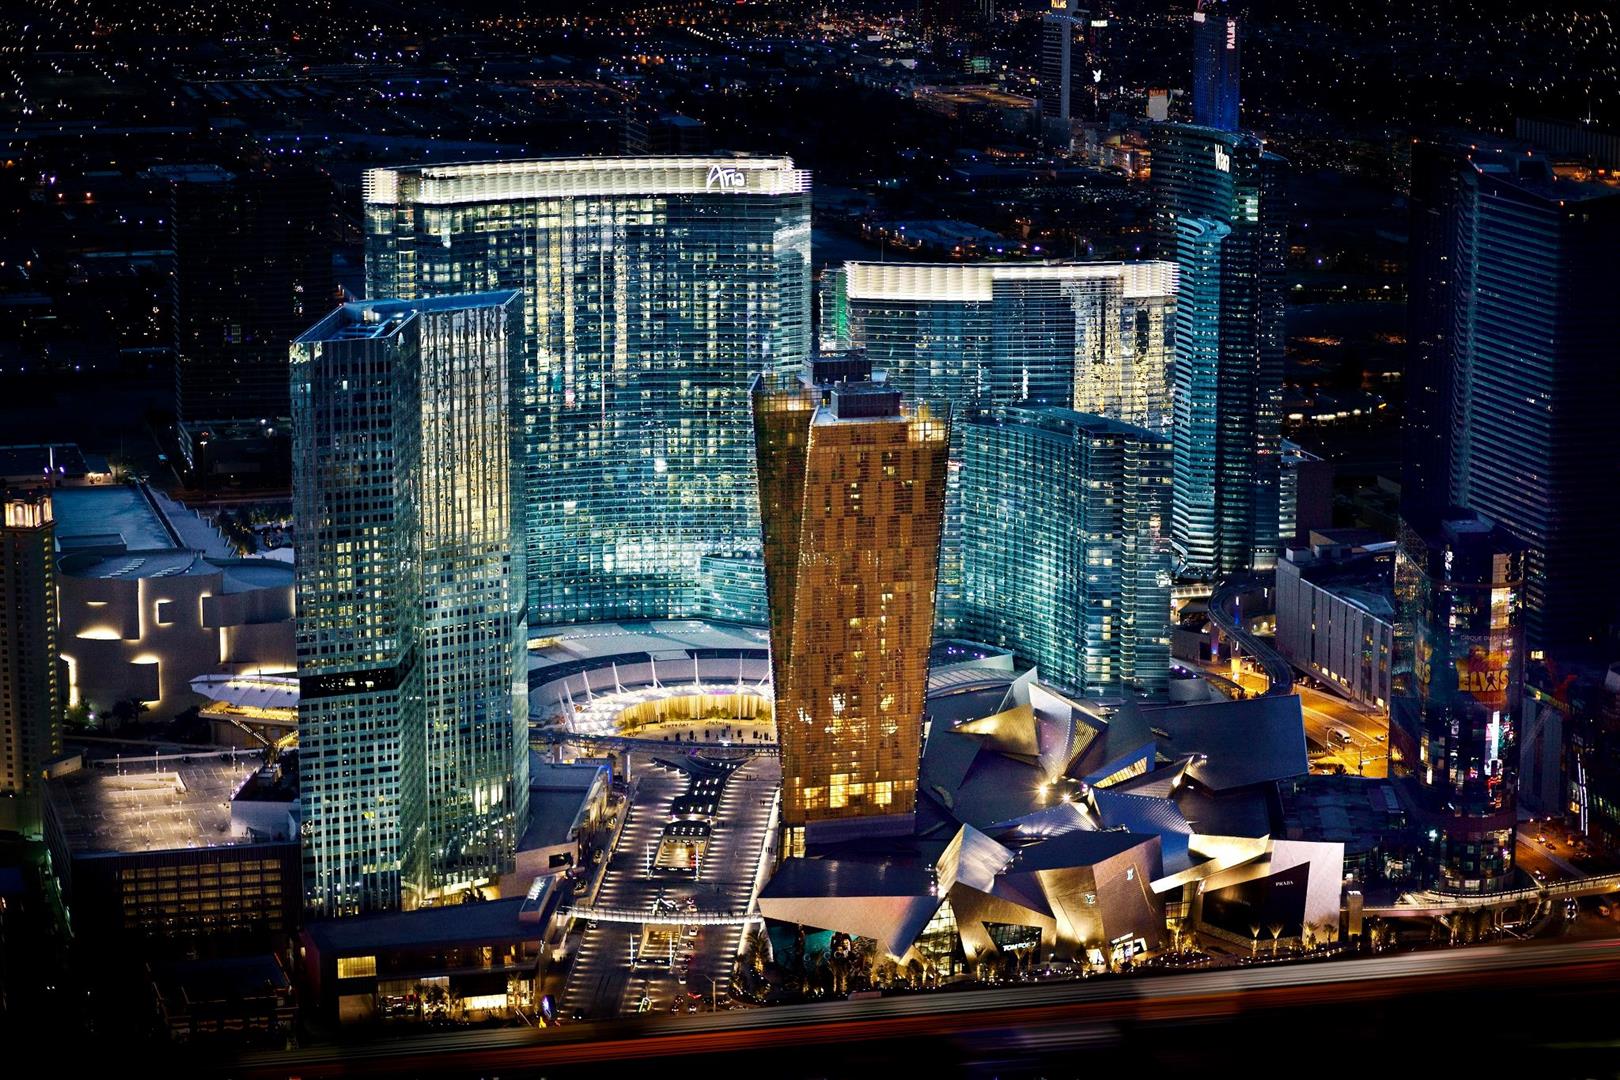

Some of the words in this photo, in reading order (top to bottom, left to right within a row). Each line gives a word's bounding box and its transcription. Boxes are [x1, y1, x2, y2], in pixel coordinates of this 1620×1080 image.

[1227, 21, 1235, 49] PALMS
[1458, 669, 1510, 691] ELVIS
[1003, 943, 1018, 951] TOM
